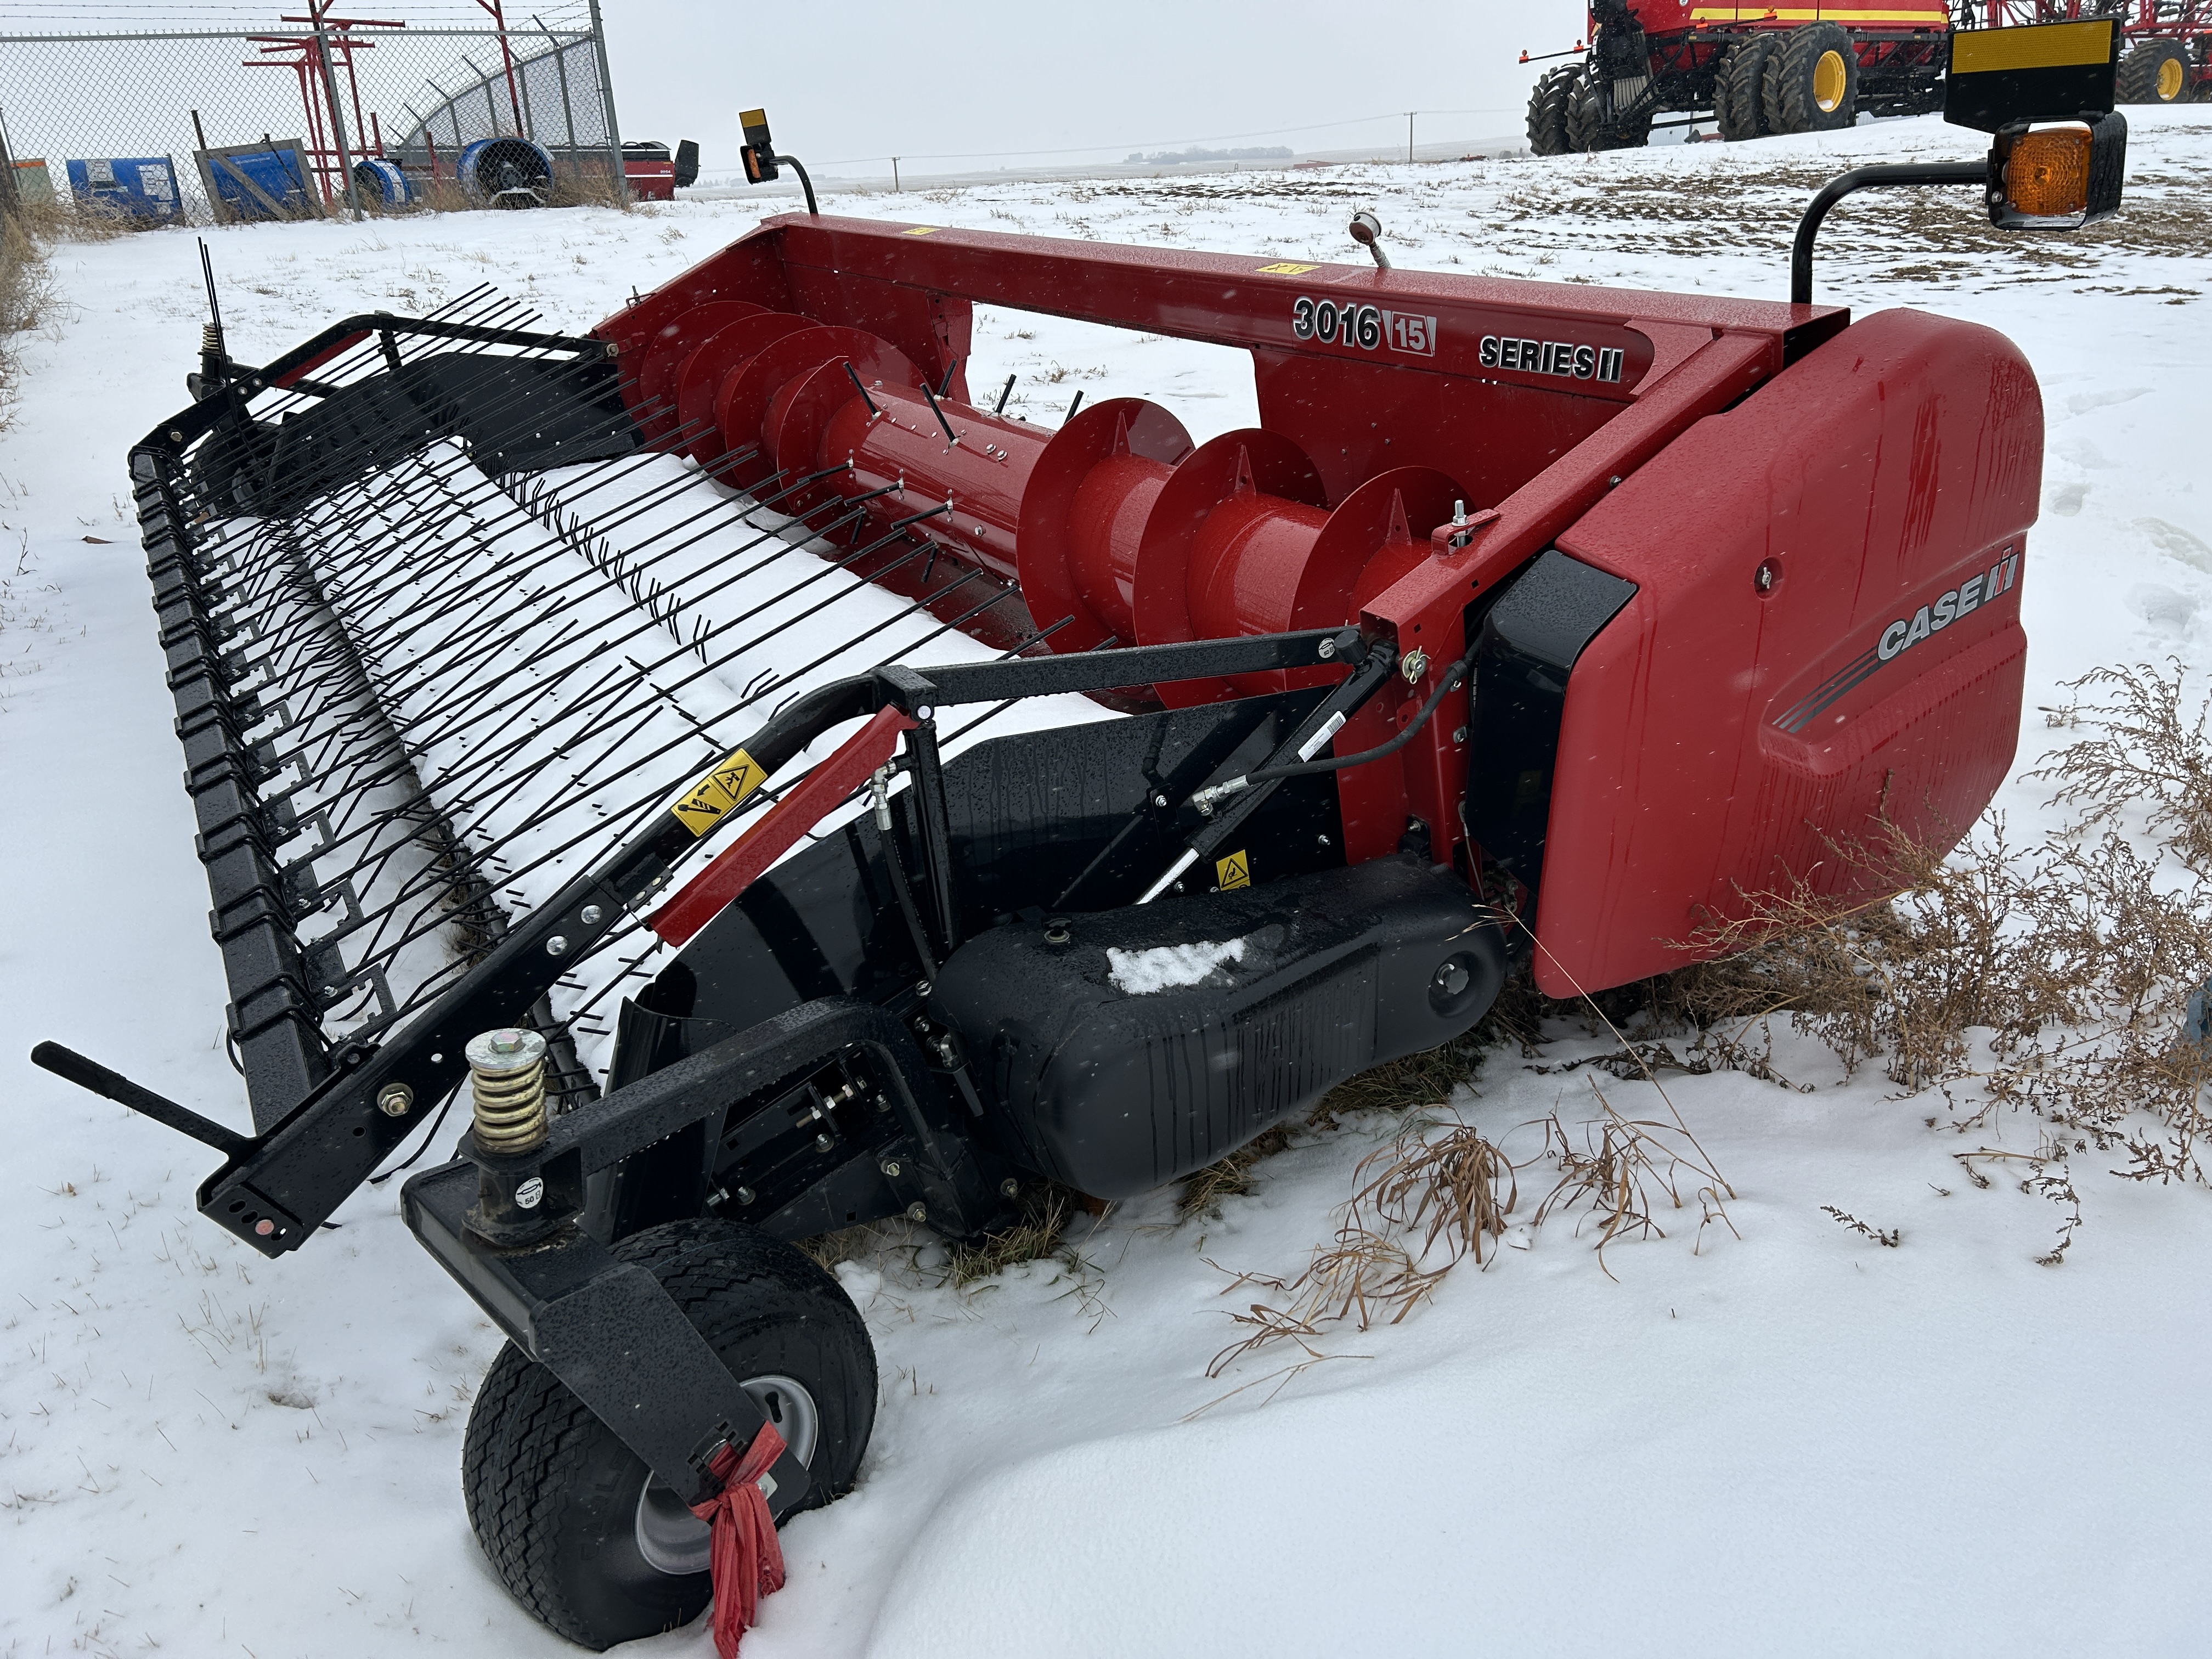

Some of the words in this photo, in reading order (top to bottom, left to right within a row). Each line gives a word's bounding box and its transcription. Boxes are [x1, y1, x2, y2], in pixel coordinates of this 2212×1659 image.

[1293, 296, 1381, 351] 3016
[1395, 318, 1426, 351] 15
[1479, 335, 1595, 380] SERIES
[1596, 346, 1624, 383] II
[1877, 573, 1984, 661] CASE
[525, 1196, 534, 1204] 50
